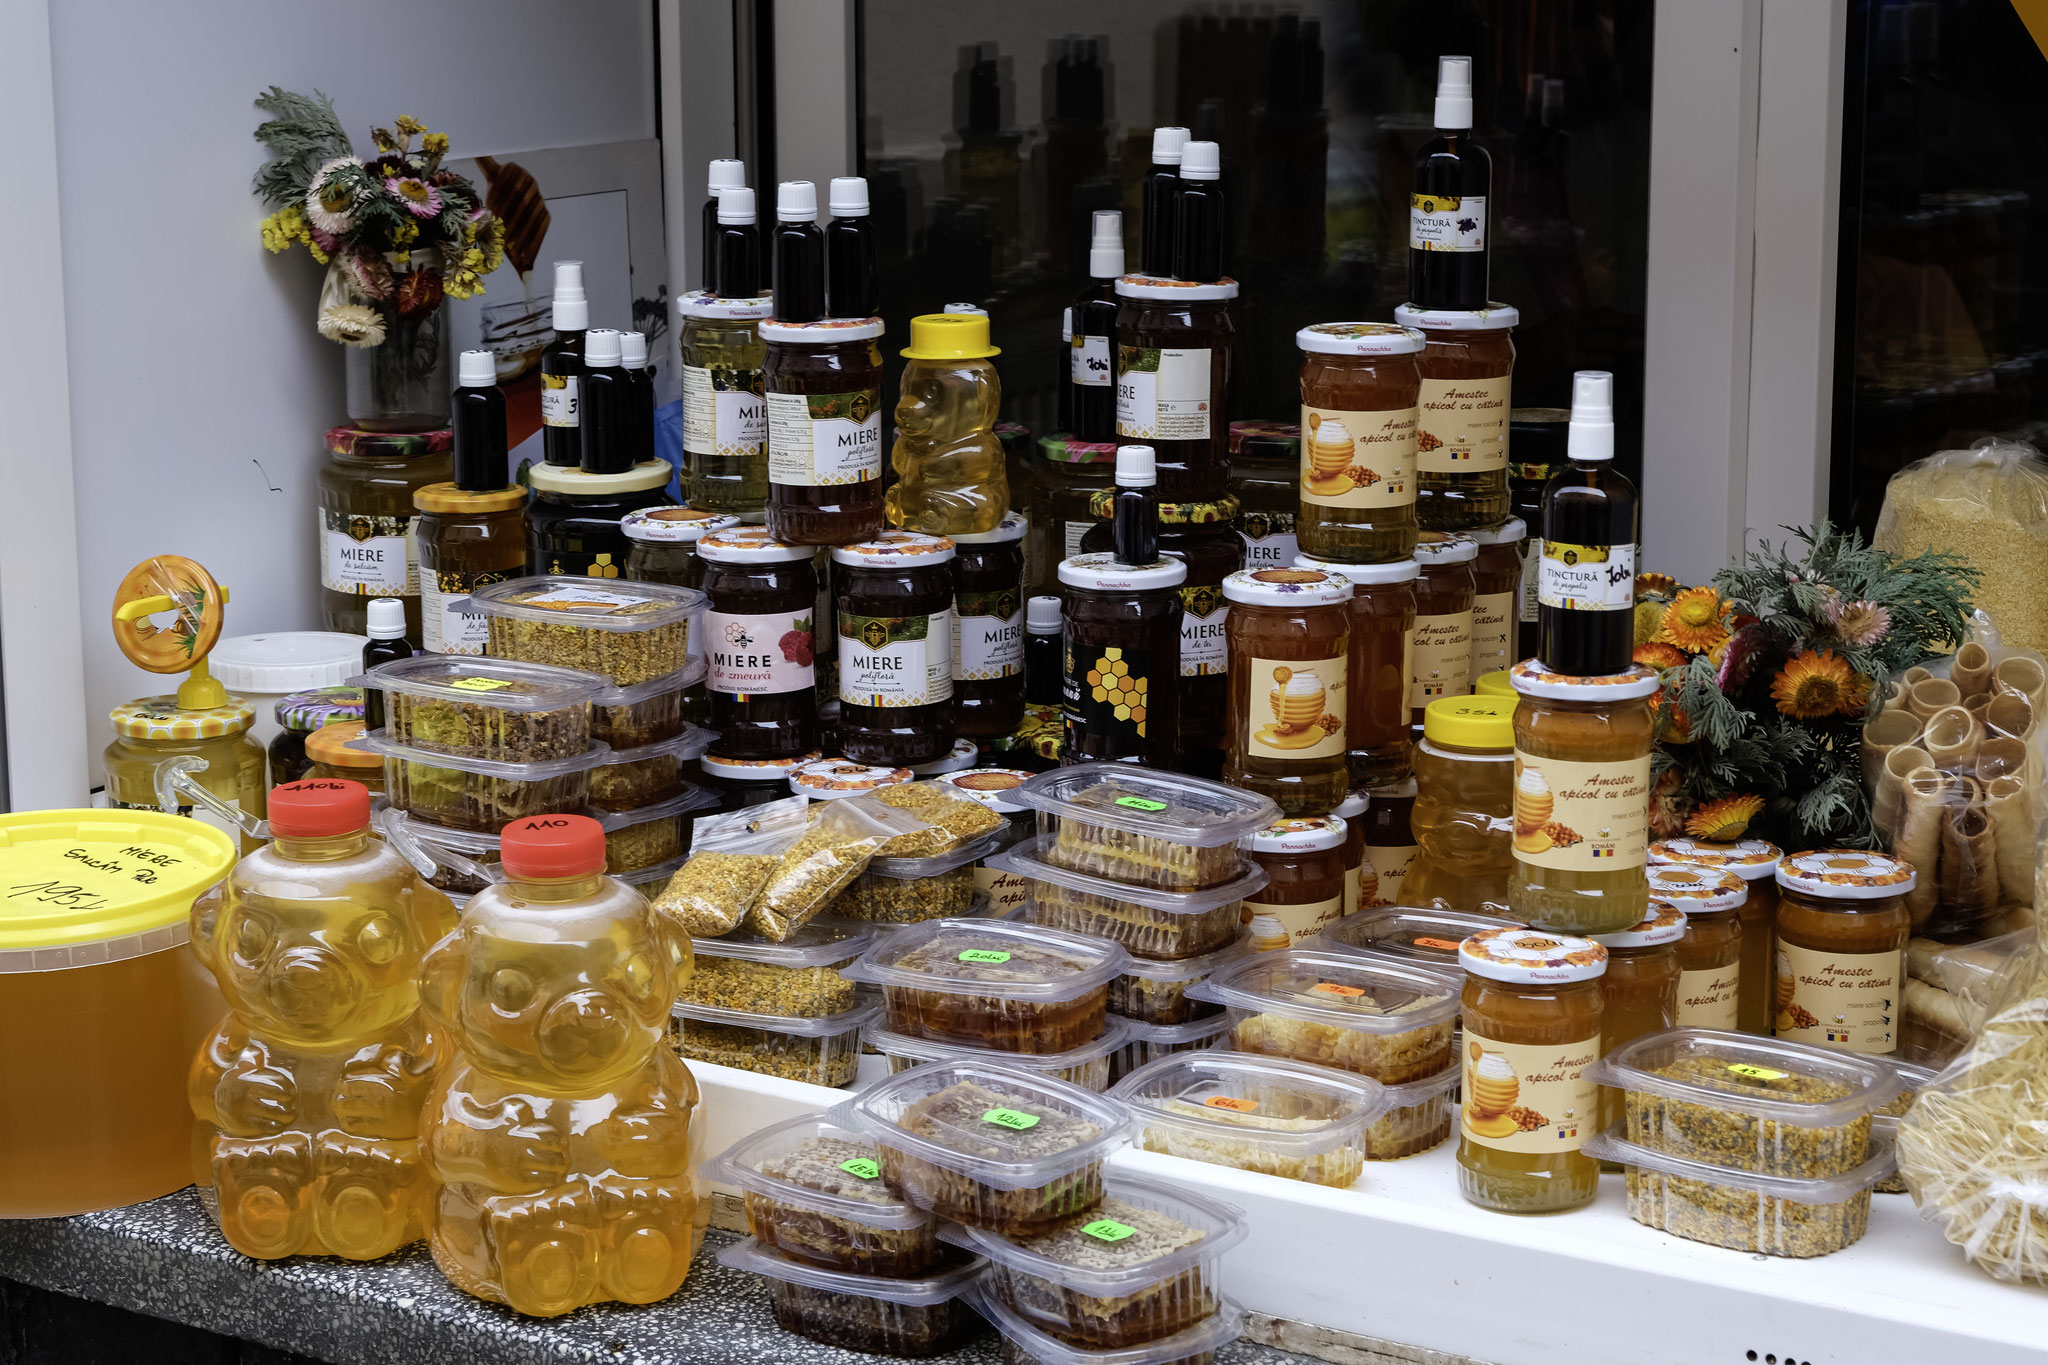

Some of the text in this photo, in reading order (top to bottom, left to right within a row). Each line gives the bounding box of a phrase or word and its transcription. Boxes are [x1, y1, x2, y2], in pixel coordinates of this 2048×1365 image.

[1443, 388, 1488, 399] Amestec
[1424, 401, 1457, 411] apicol
[837, 427, 878, 447] MIERE
[1360, 432, 1393, 445] apicol
[340, 548, 384, 562] MIERE
[1248, 547, 1281, 560] IERE
[1547, 568, 1598, 581] TINCTURĂ
[1180, 623, 1224, 640] MIERE
[1418, 624, 1459, 635] Amestec
[1192, 640, 1201, 649] de
[714, 653, 772, 667] MIERE
[853, 655, 902, 670] MIERE
[714, 667, 772, 680] de zmeură
[860, 671, 895, 683] polifloră
[1584, 773, 1635, 786] Amestec
[1559, 788, 1600, 801] apicol
[1383, 868, 1407, 878] apic
[1530, 972, 1569, 980] Pannachka
[1819, 963, 1873, 976] Amestec
[1799, 975, 1892, 989] apicol cu cătină
[1685, 992, 1719, 1008] apicol
[1551, 1054, 1594, 1070] Amestec
[1525, 1070, 1581, 1085] apicol cu
